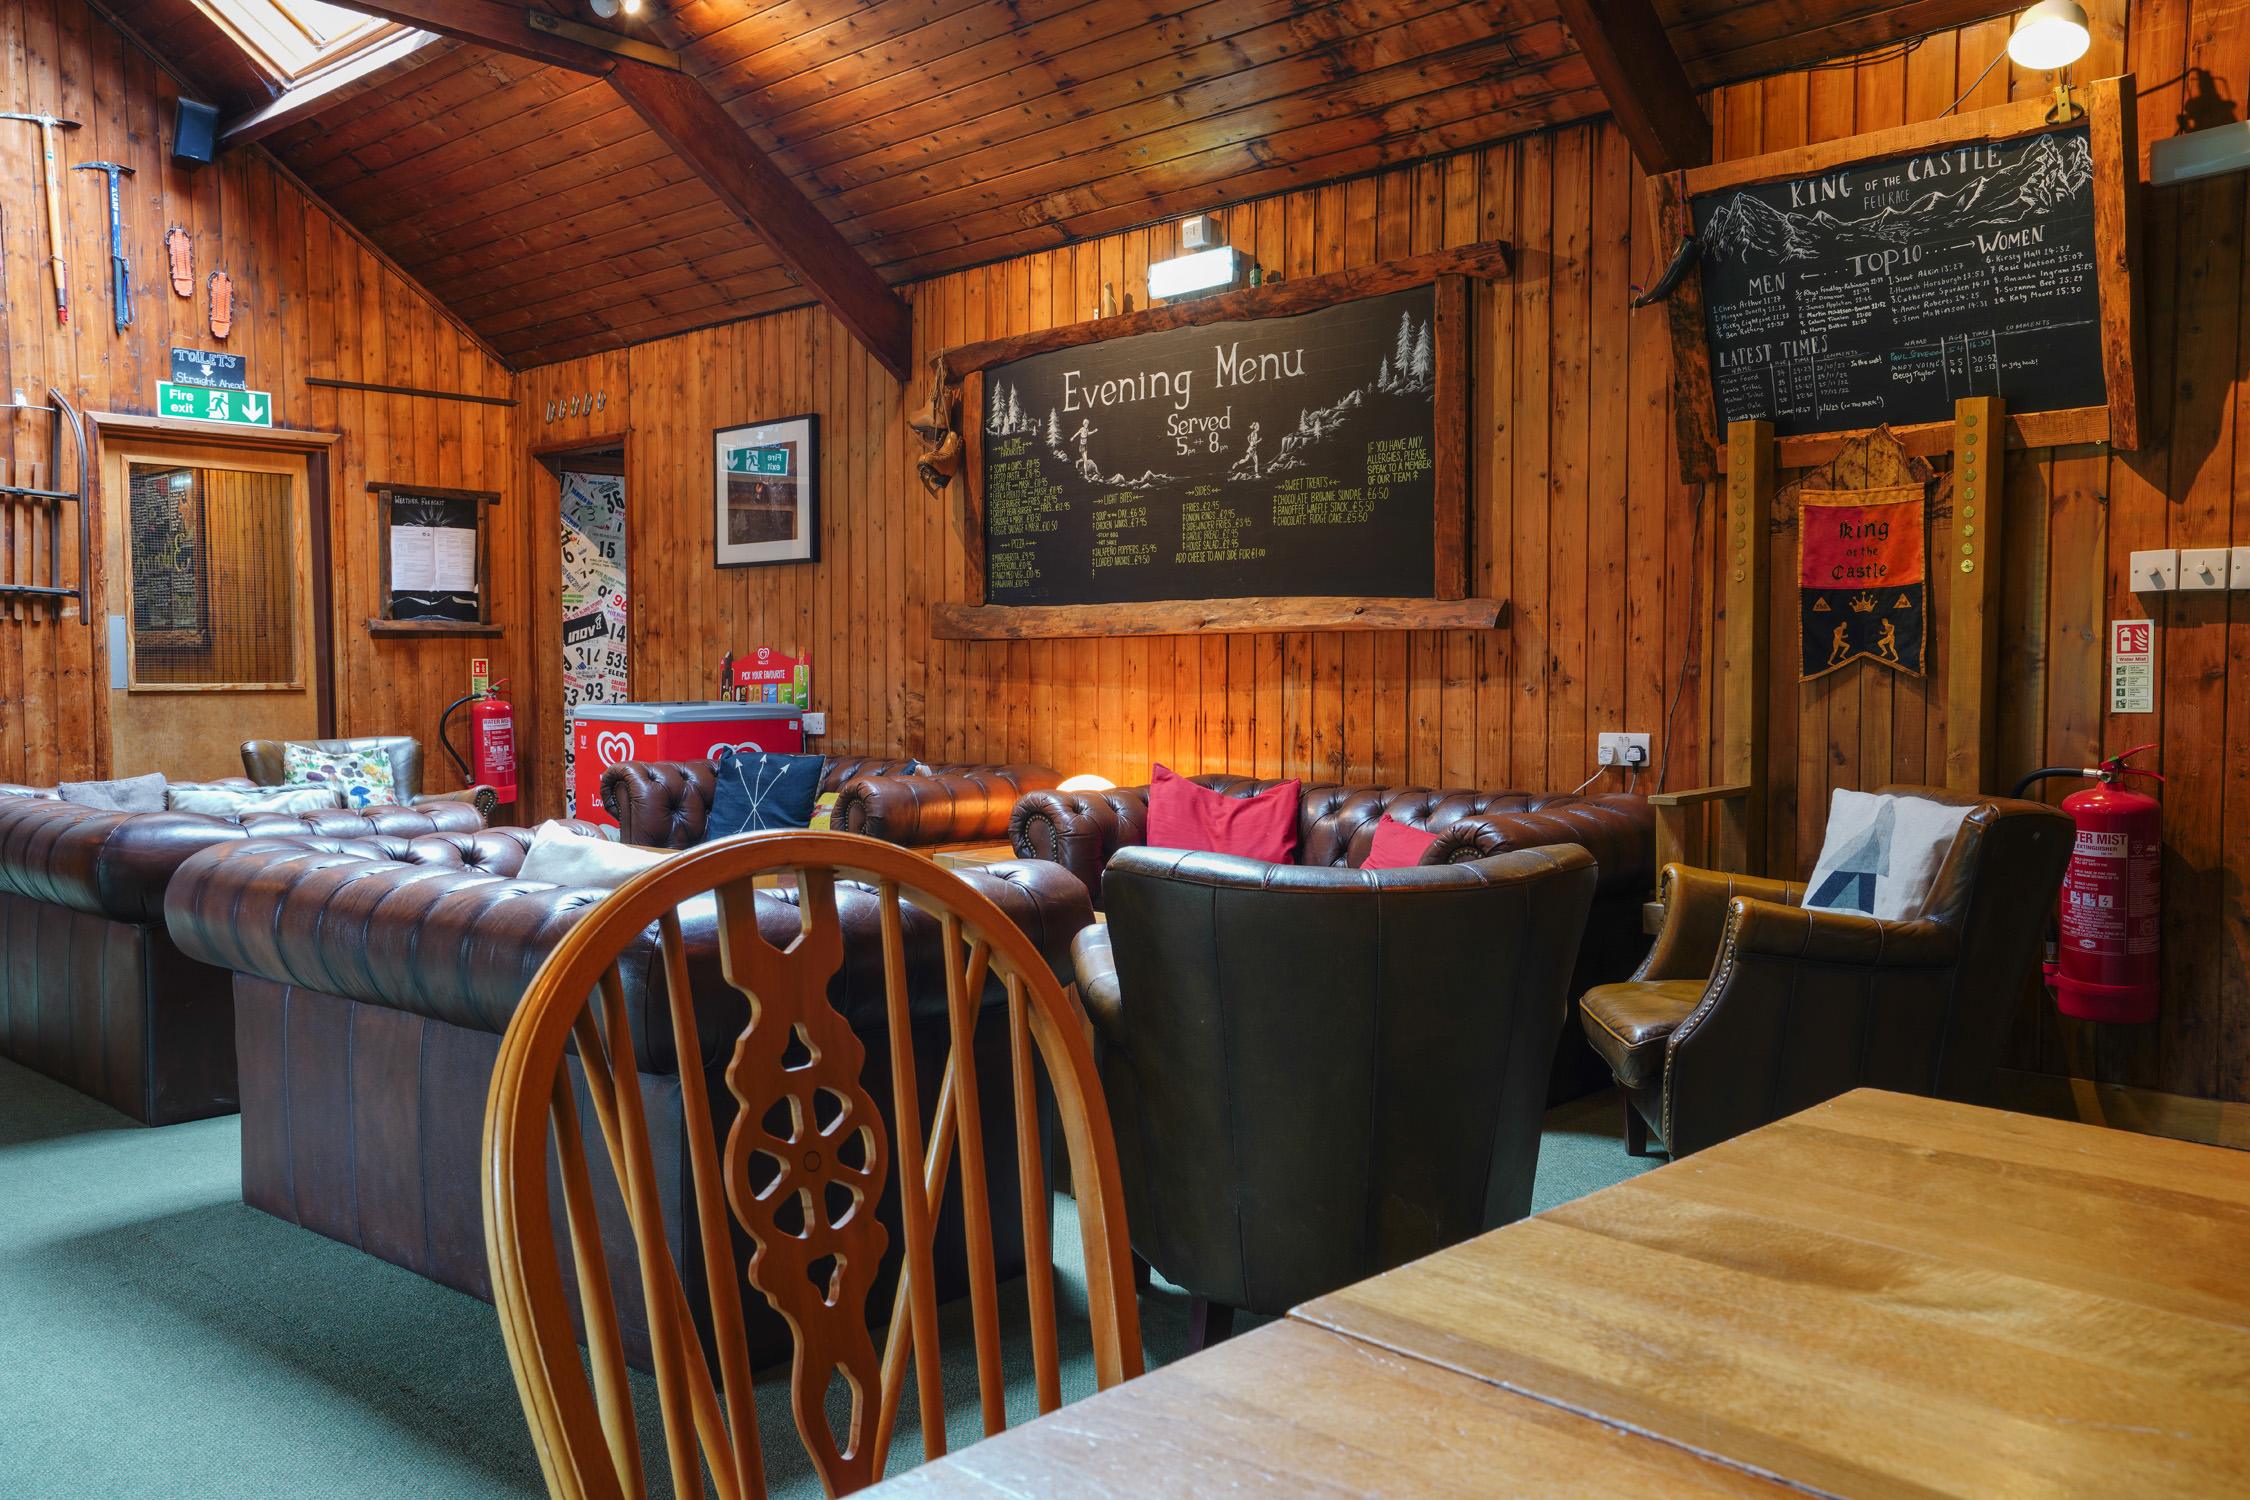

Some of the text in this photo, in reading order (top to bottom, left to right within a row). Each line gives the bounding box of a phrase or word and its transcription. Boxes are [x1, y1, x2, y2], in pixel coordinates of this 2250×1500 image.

[1789, 144, 2001, 208] KING OF THE CASTLE
[1977, 224, 2045, 255] WOMEN
[2023, 249, 2041, 258] Hall
[2024, 258, 2055, 269] Watson
[1748, 272, 1786, 297] MEN
[1719, 334, 1828, 368] LATEST TIMES
[1063, 342, 1305, 412] Evening Menu
[169, 388, 194, 401] Fire
[170, 403, 194, 414] exit
[1167, 405, 1232, 437] Served
[1376, 440, 1388, 452] YOU
[1389, 438, 1407, 451] HAVE
[1408, 435, 1423, 449] ANY
[1404, 448, 1427, 461] PLEASE
[1367, 459, 1432, 474] SPEAK TO A MEMBER
[1377, 474, 1390, 484] OUR
[1392, 471, 1411, 482] TEAM
[603, 490, 625, 514] 36
[599, 540, 615, 559] 15
[1860, 545, 1878, 556] the
[1832, 562, 1887, 581] Castle
[2096, 833, 2127, 846] MIST
